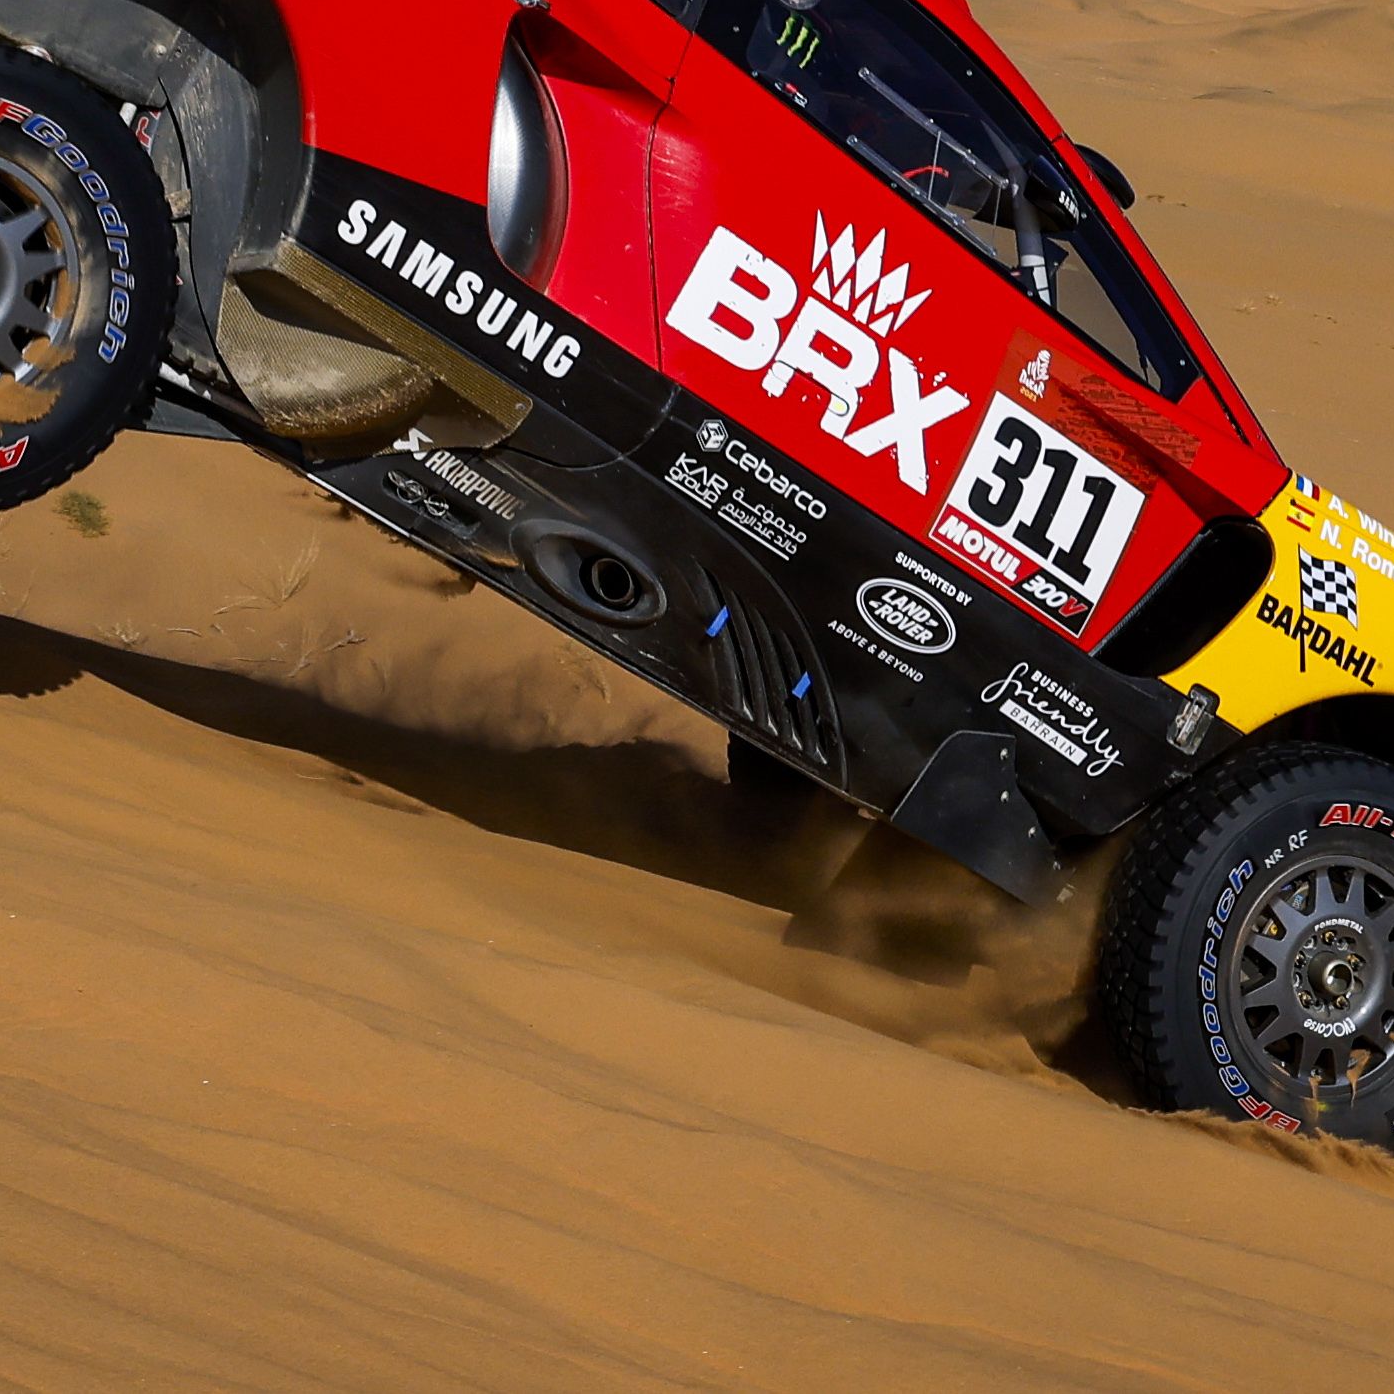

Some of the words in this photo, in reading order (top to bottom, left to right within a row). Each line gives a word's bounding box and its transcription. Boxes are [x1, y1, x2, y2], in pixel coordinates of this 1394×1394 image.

[337, 199, 581, 379] SAMSUNG
[665, 225, 970, 497] BRX
[669, 466, 719, 504] group
[675, 452, 728, 495] KAR
[725, 439, 827, 519] Cebarco
[968, 416, 1116, 586] 311
[1320, 519, 1342, 550] N.
[1328, 494, 1350, 519] A.
[895, 551, 956, 597] SUPPORTED
[955, 590, 973, 607] BY
[938, 513, 1022, 582] MOTUL
[1022, 573, 1089, 618] 300V
[874, 605, 933, 645] ROVER
[881, 588, 933, 624] LAND
[827, 619, 868, 648] ABOVE
[867, 642, 879, 655] &
[877, 649, 924, 683] BEYOND
[1256, 592, 1377, 688] BARDAHL
[980, 661, 1124, 777] friendly
[1030, 669, 1094, 718] BUSINESS
[1009, 706, 1077, 757] BAHRAIN
[1264, 847, 1285, 869] NR
[1288, 829, 1309, 852] RF
[1198, 858, 1301, 1134] BFGoodrich
